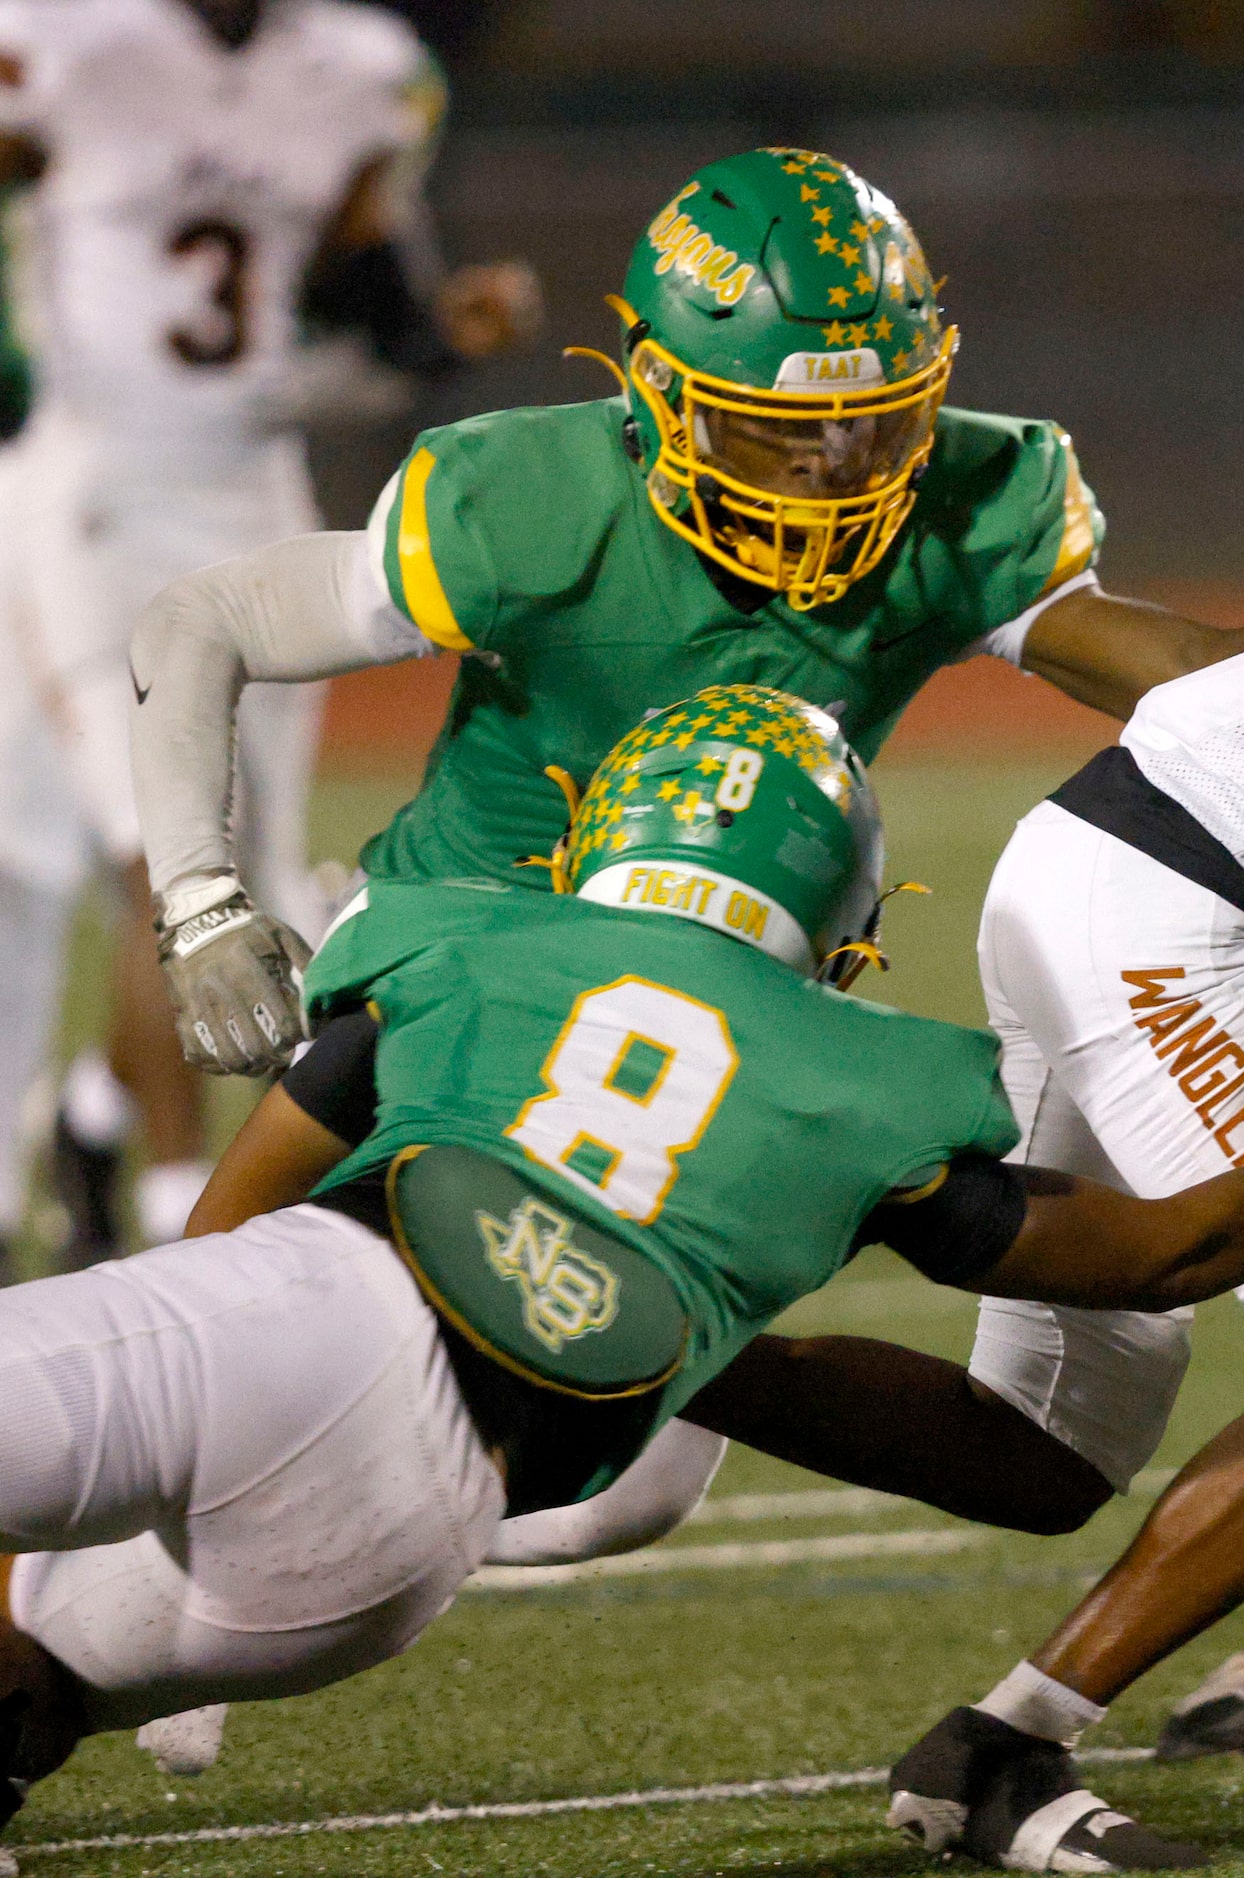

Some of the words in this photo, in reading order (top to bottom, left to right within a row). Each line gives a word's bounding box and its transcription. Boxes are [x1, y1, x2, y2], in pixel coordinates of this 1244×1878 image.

[167, 214, 247, 371] 3
[804, 355, 862, 380] TAAT
[716, 747, 765, 812] 8
[621, 866, 719, 915] FIGHT
[725, 890, 770, 941] ON
[501, 973, 740, 1226] 8
